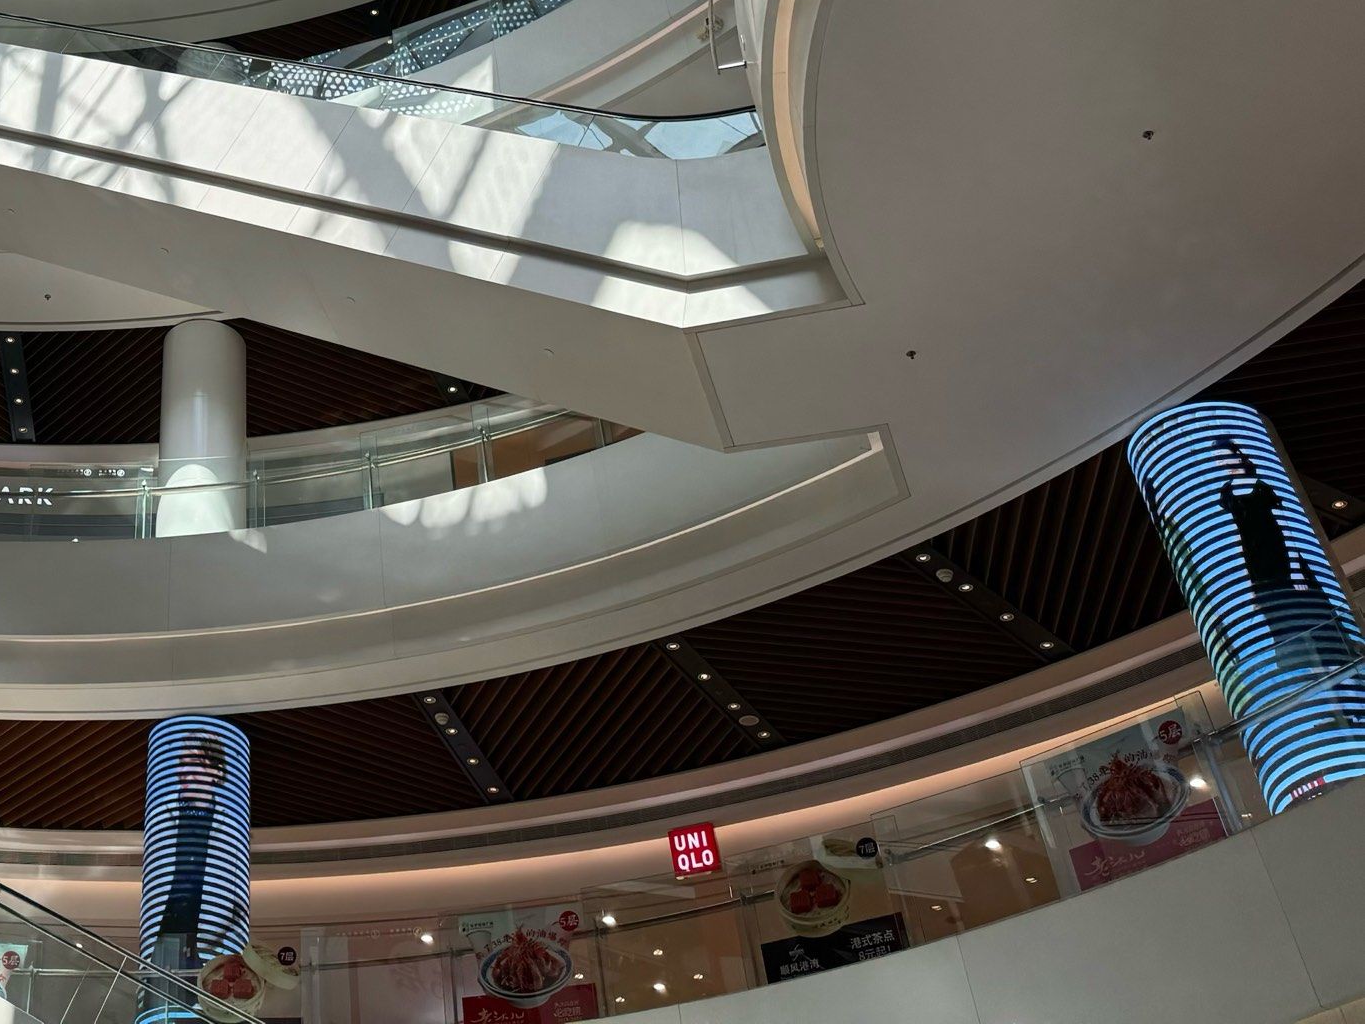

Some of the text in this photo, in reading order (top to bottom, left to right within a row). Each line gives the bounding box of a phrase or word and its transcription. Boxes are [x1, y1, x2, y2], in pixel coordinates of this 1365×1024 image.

[1159, 723, 1182, 743] 5层
[674, 830, 708, 852] UNI
[677, 848, 714, 873] QLO
[560, 914, 579, 928] 5层
[850, 929, 896, 950] 港式茶点
[2, 954, 20, 967] 5层
